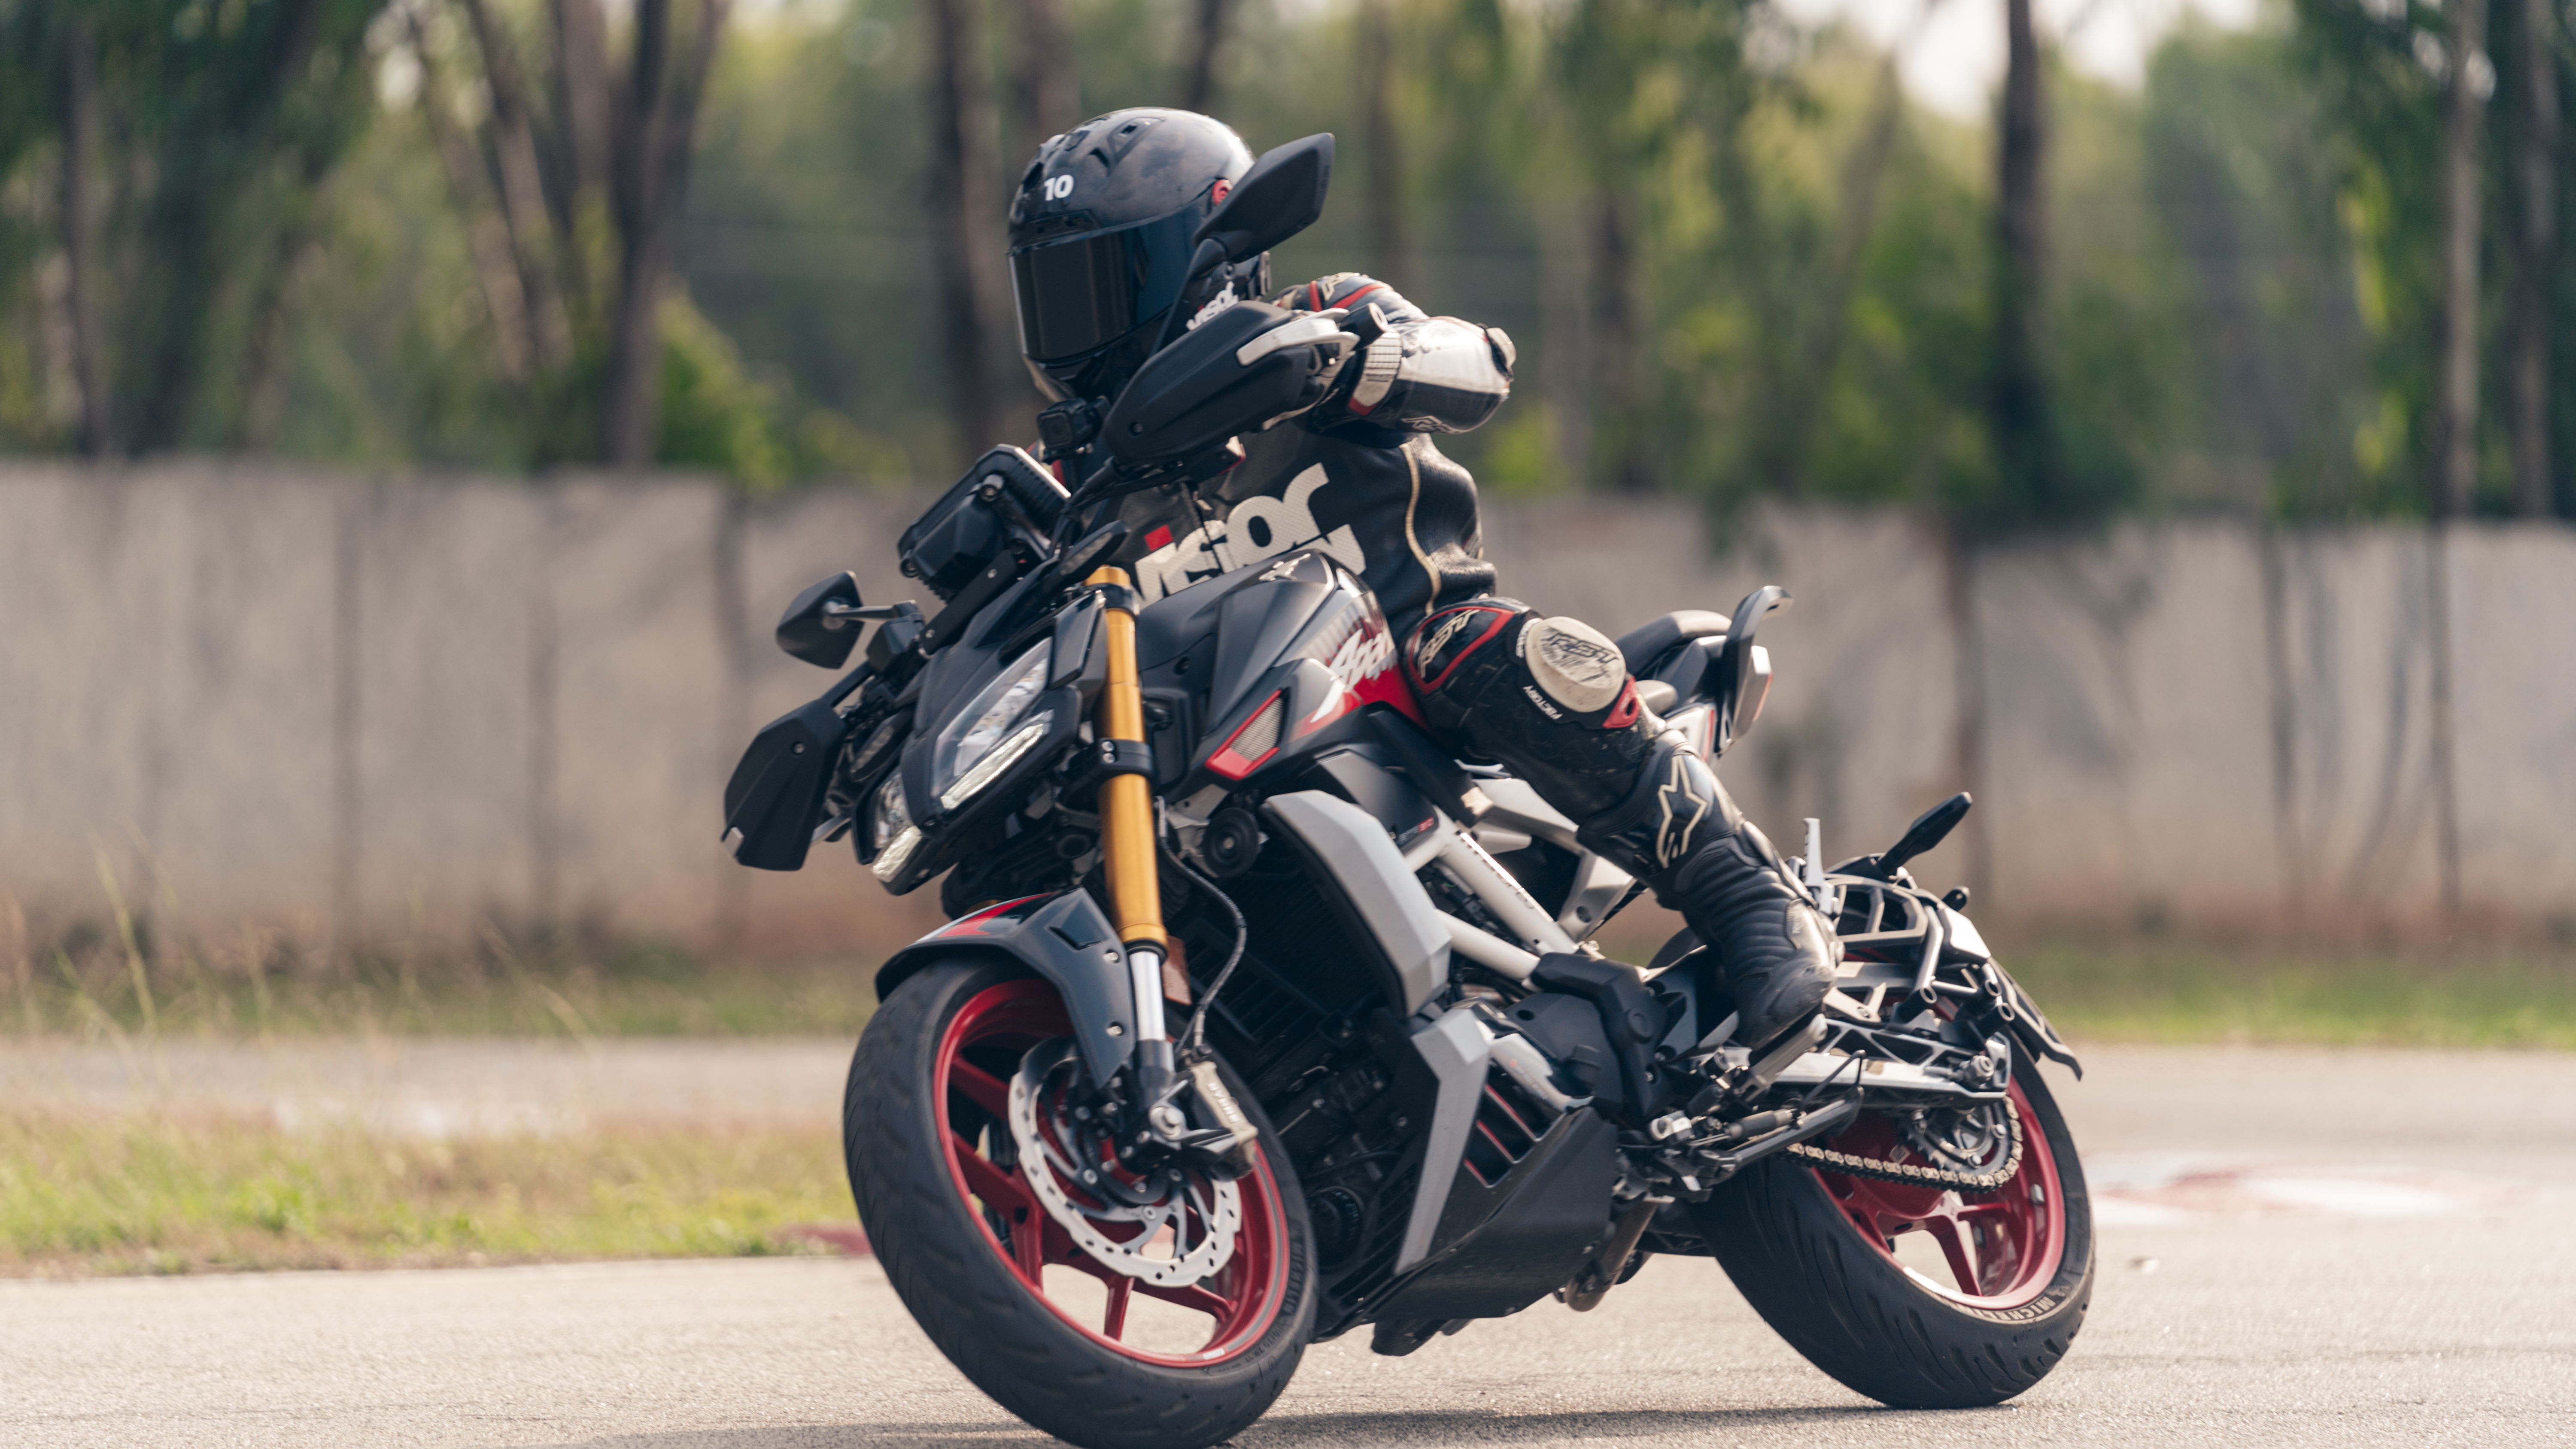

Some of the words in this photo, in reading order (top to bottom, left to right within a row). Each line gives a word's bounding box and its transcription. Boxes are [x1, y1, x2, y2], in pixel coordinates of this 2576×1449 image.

[1043, 174, 1074, 201] 10
[1417, 609, 1480, 678] RST
[1540, 632, 1620, 664] RST
